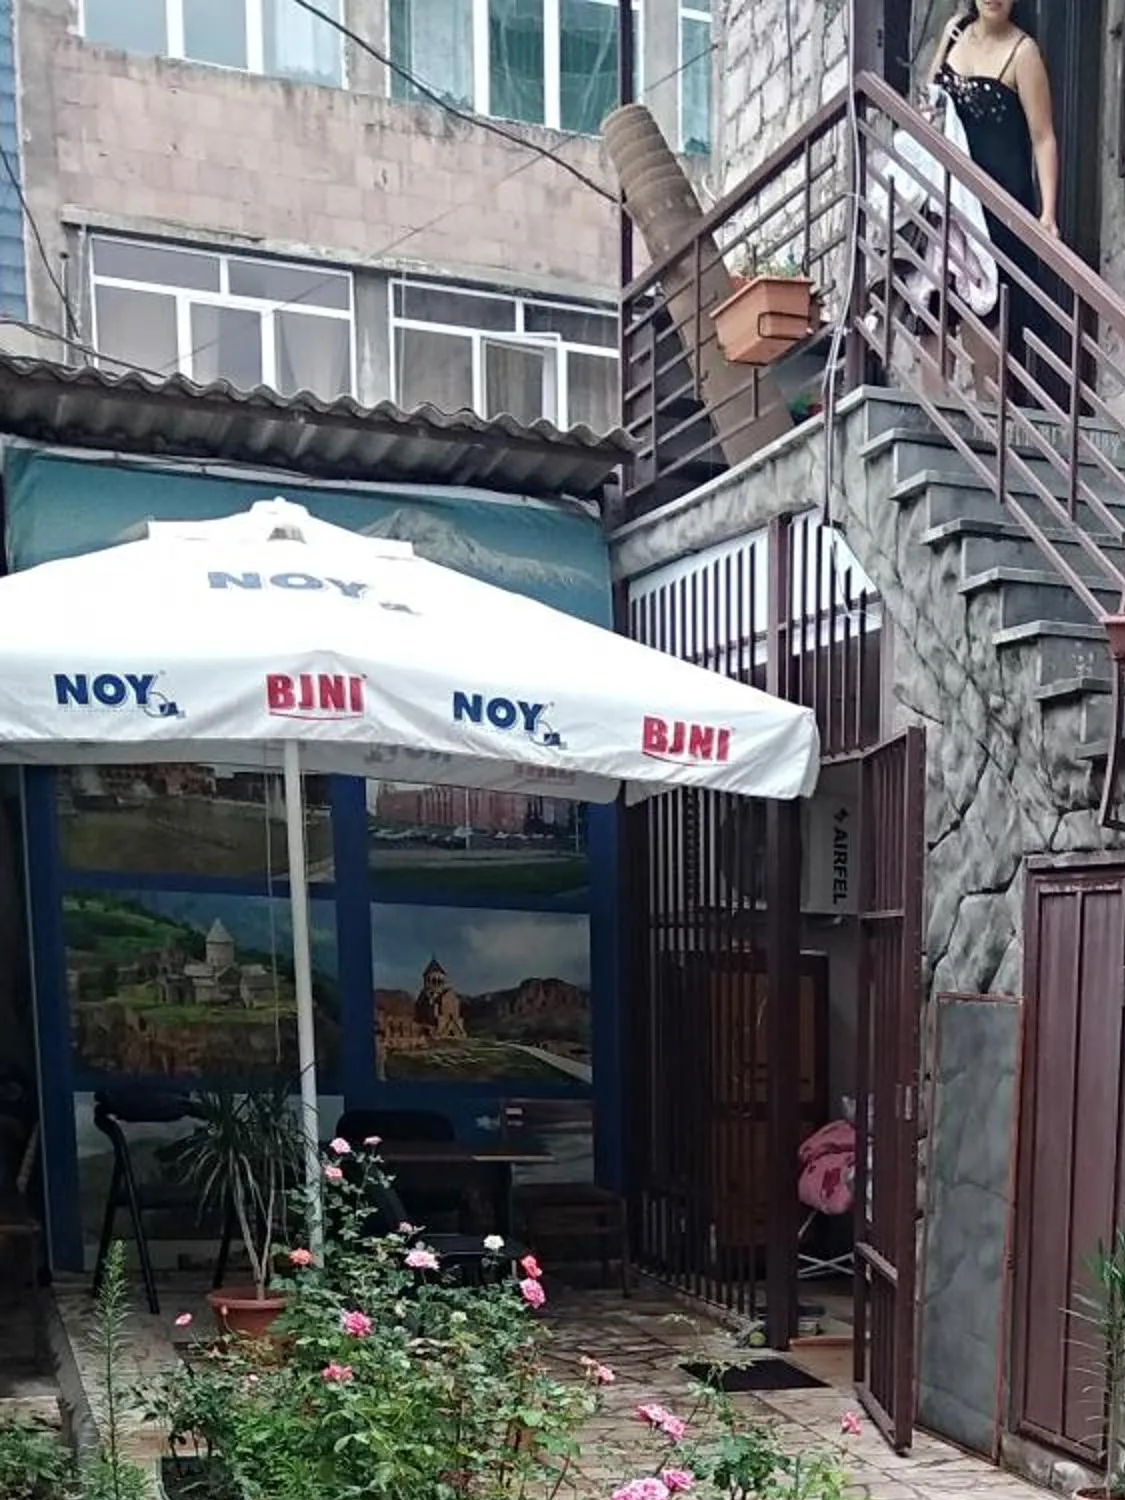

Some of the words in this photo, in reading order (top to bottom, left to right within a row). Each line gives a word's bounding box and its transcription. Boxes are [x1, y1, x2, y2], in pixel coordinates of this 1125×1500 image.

[207, 571, 369, 599] NOY
[54, 673, 154, 705] NOY
[266, 673, 364, 712] BJNI
[453, 691, 545, 732] NOY
[643, 715, 731, 762] BJNI
[833, 826, 850, 905] AIRFEL
